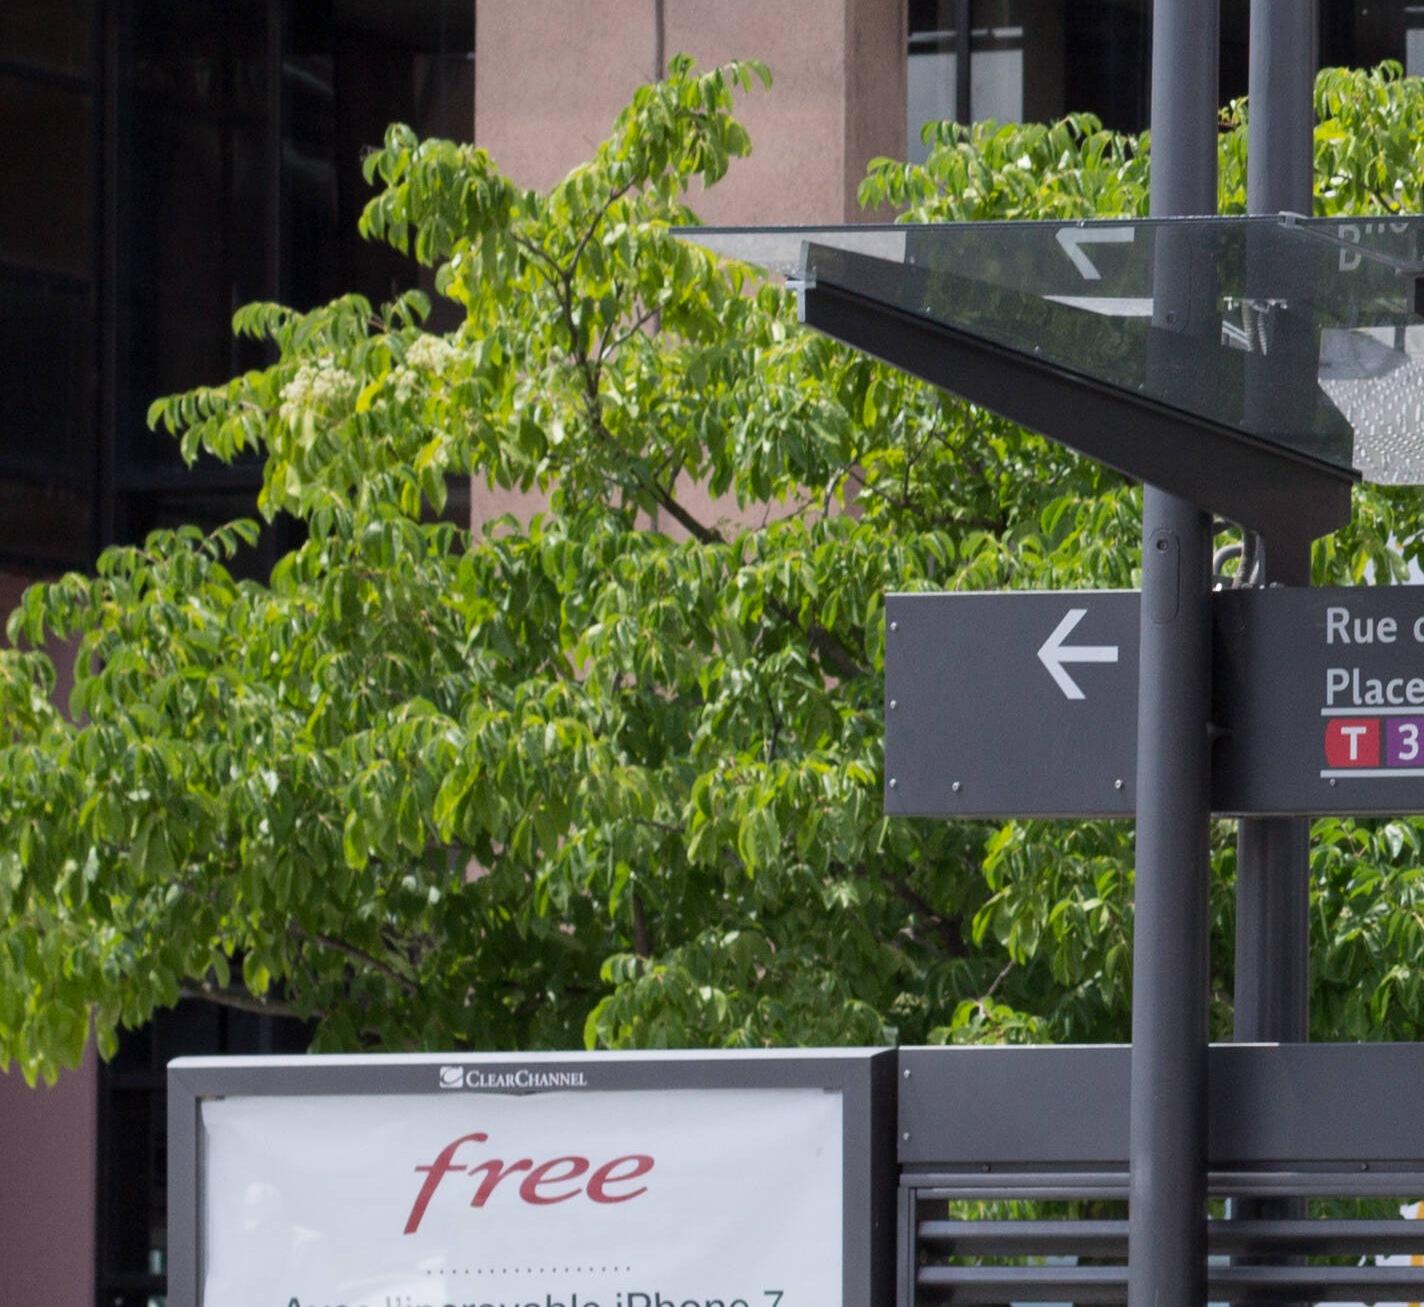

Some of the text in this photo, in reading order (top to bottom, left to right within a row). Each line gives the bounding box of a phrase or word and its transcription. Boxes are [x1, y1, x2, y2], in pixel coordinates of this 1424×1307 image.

[1326, 606, 1398, 644] Rue
[1340, 725, 1367, 761] T
[1398, 723, 1420, 761] 3
[402, 1131, 656, 1236] free
